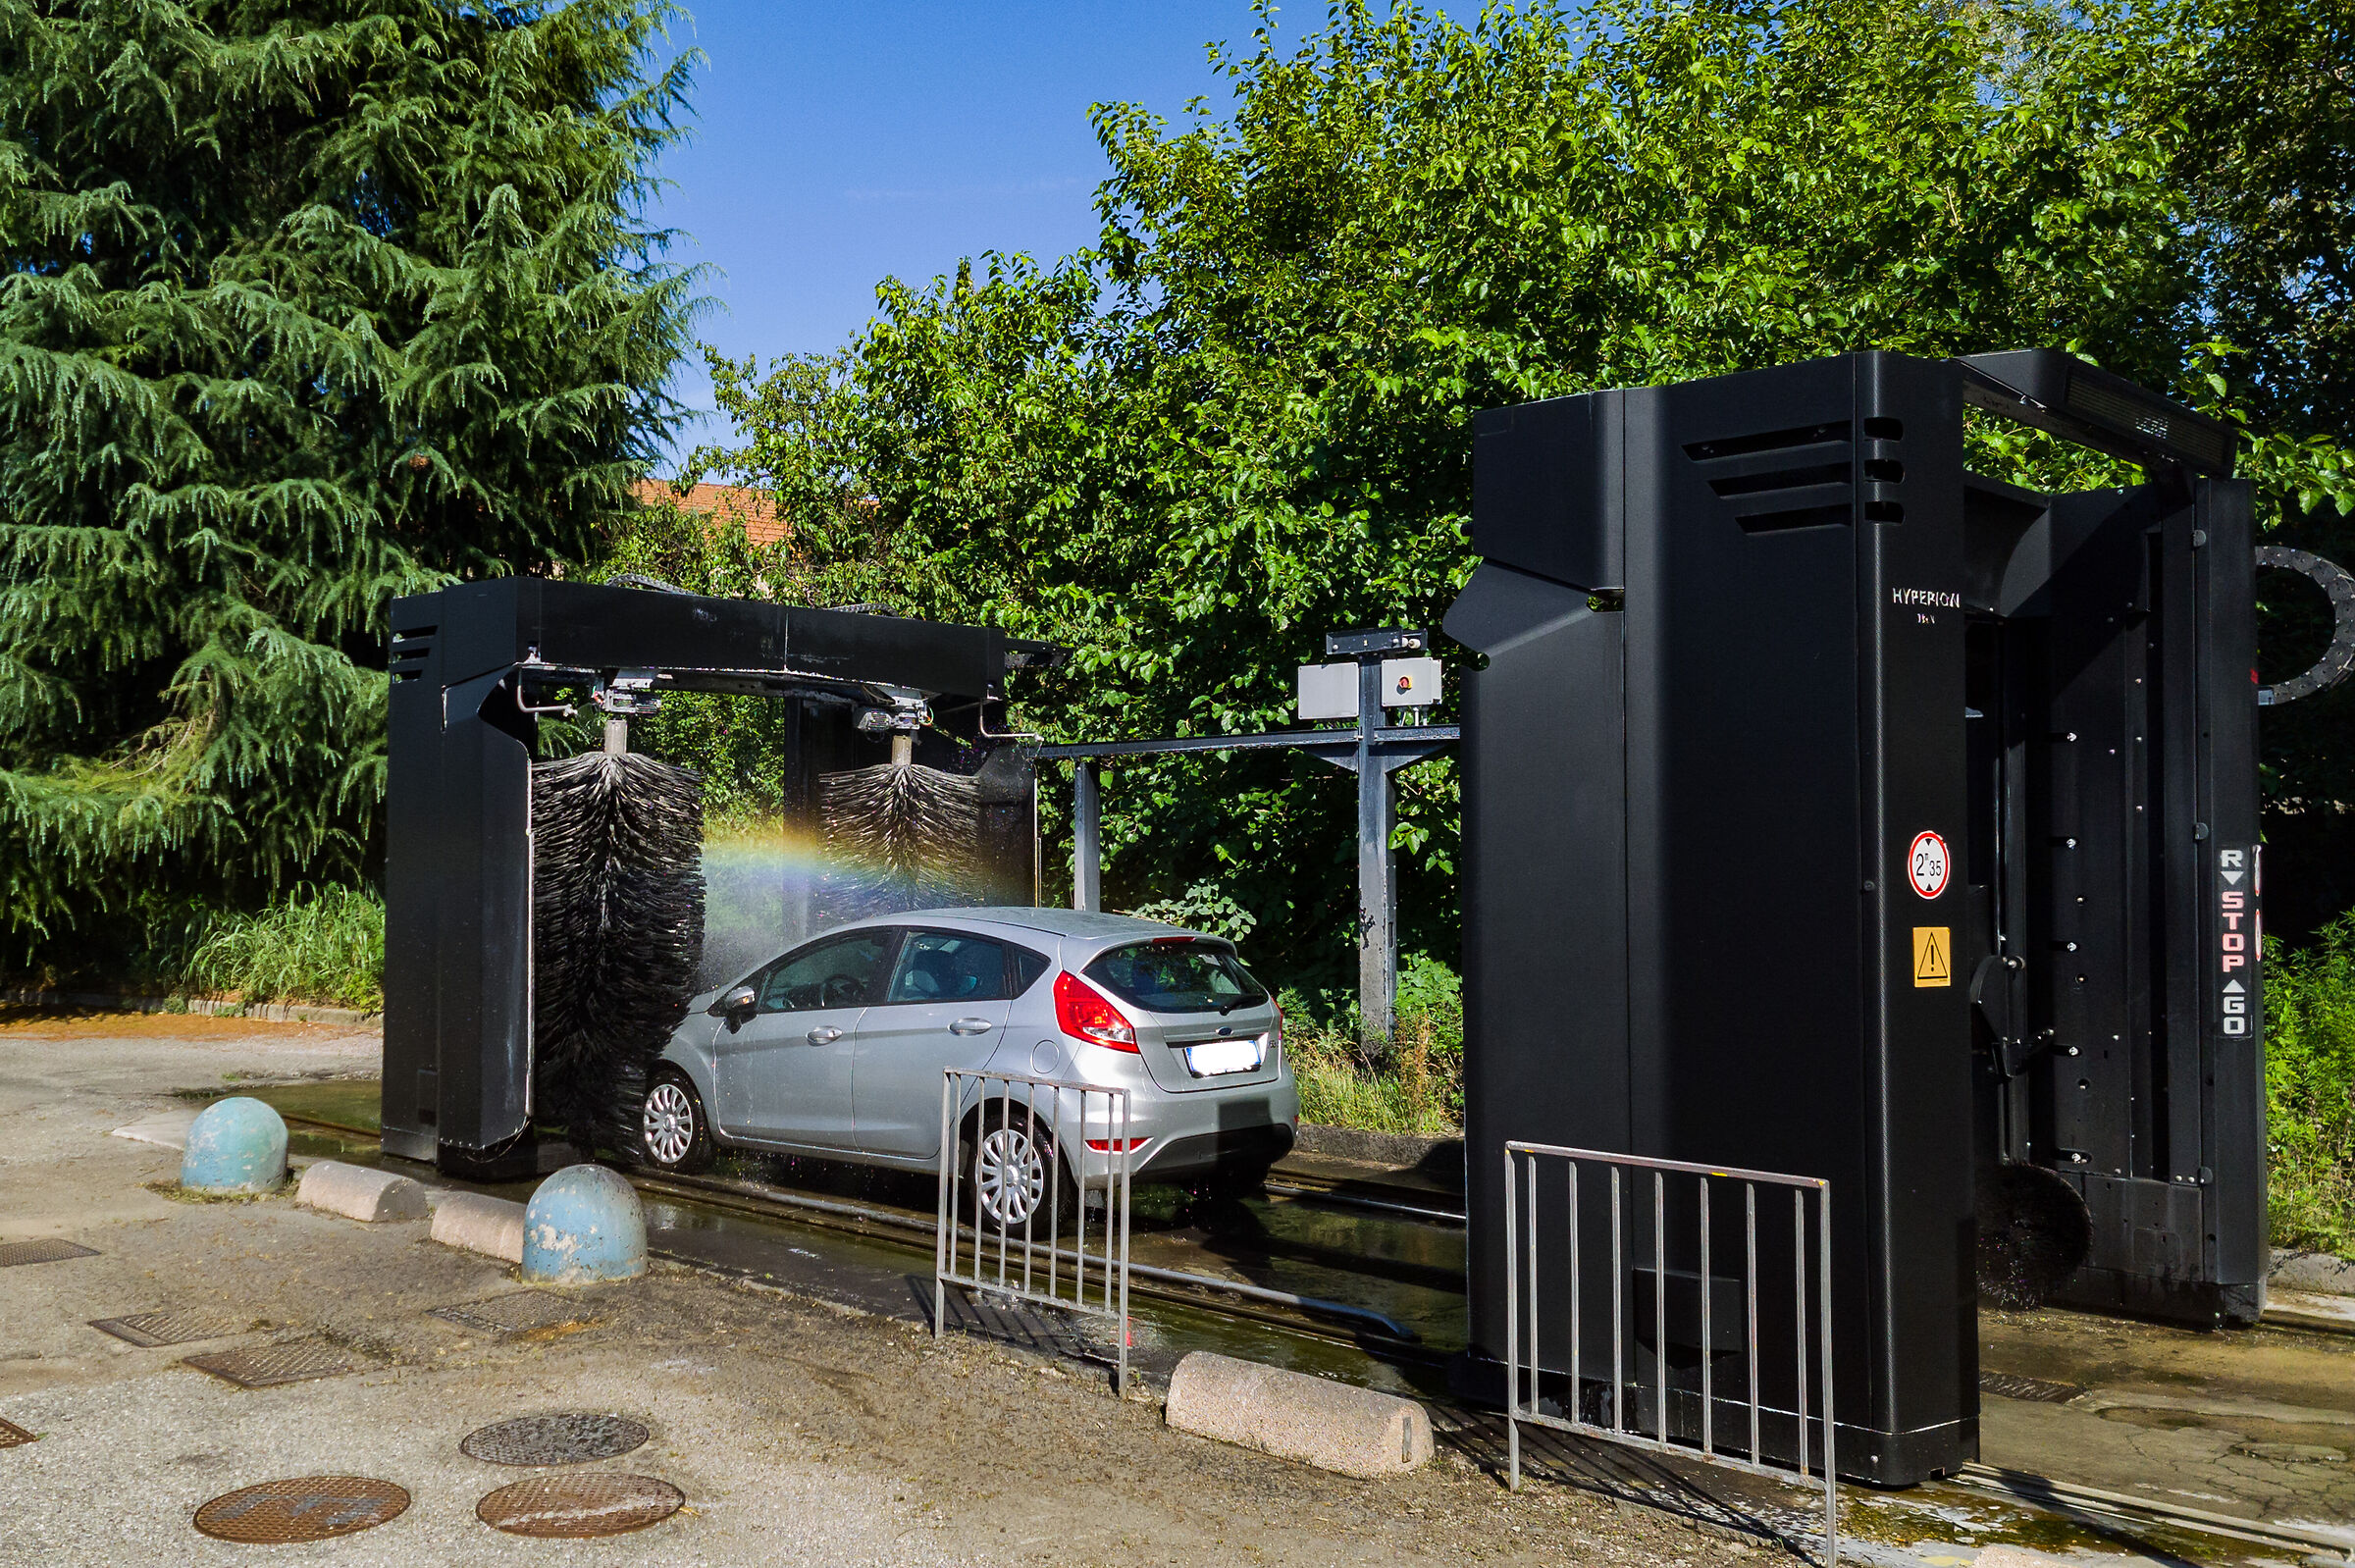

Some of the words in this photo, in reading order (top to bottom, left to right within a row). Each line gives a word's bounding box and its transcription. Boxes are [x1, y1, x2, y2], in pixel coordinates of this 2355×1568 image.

[1893, 587, 1961, 608] HYPERION
[2221, 850, 2243, 867] R
[2222, 891, 2244, 972] STOP
[2223, 996, 2245, 1034] GO
